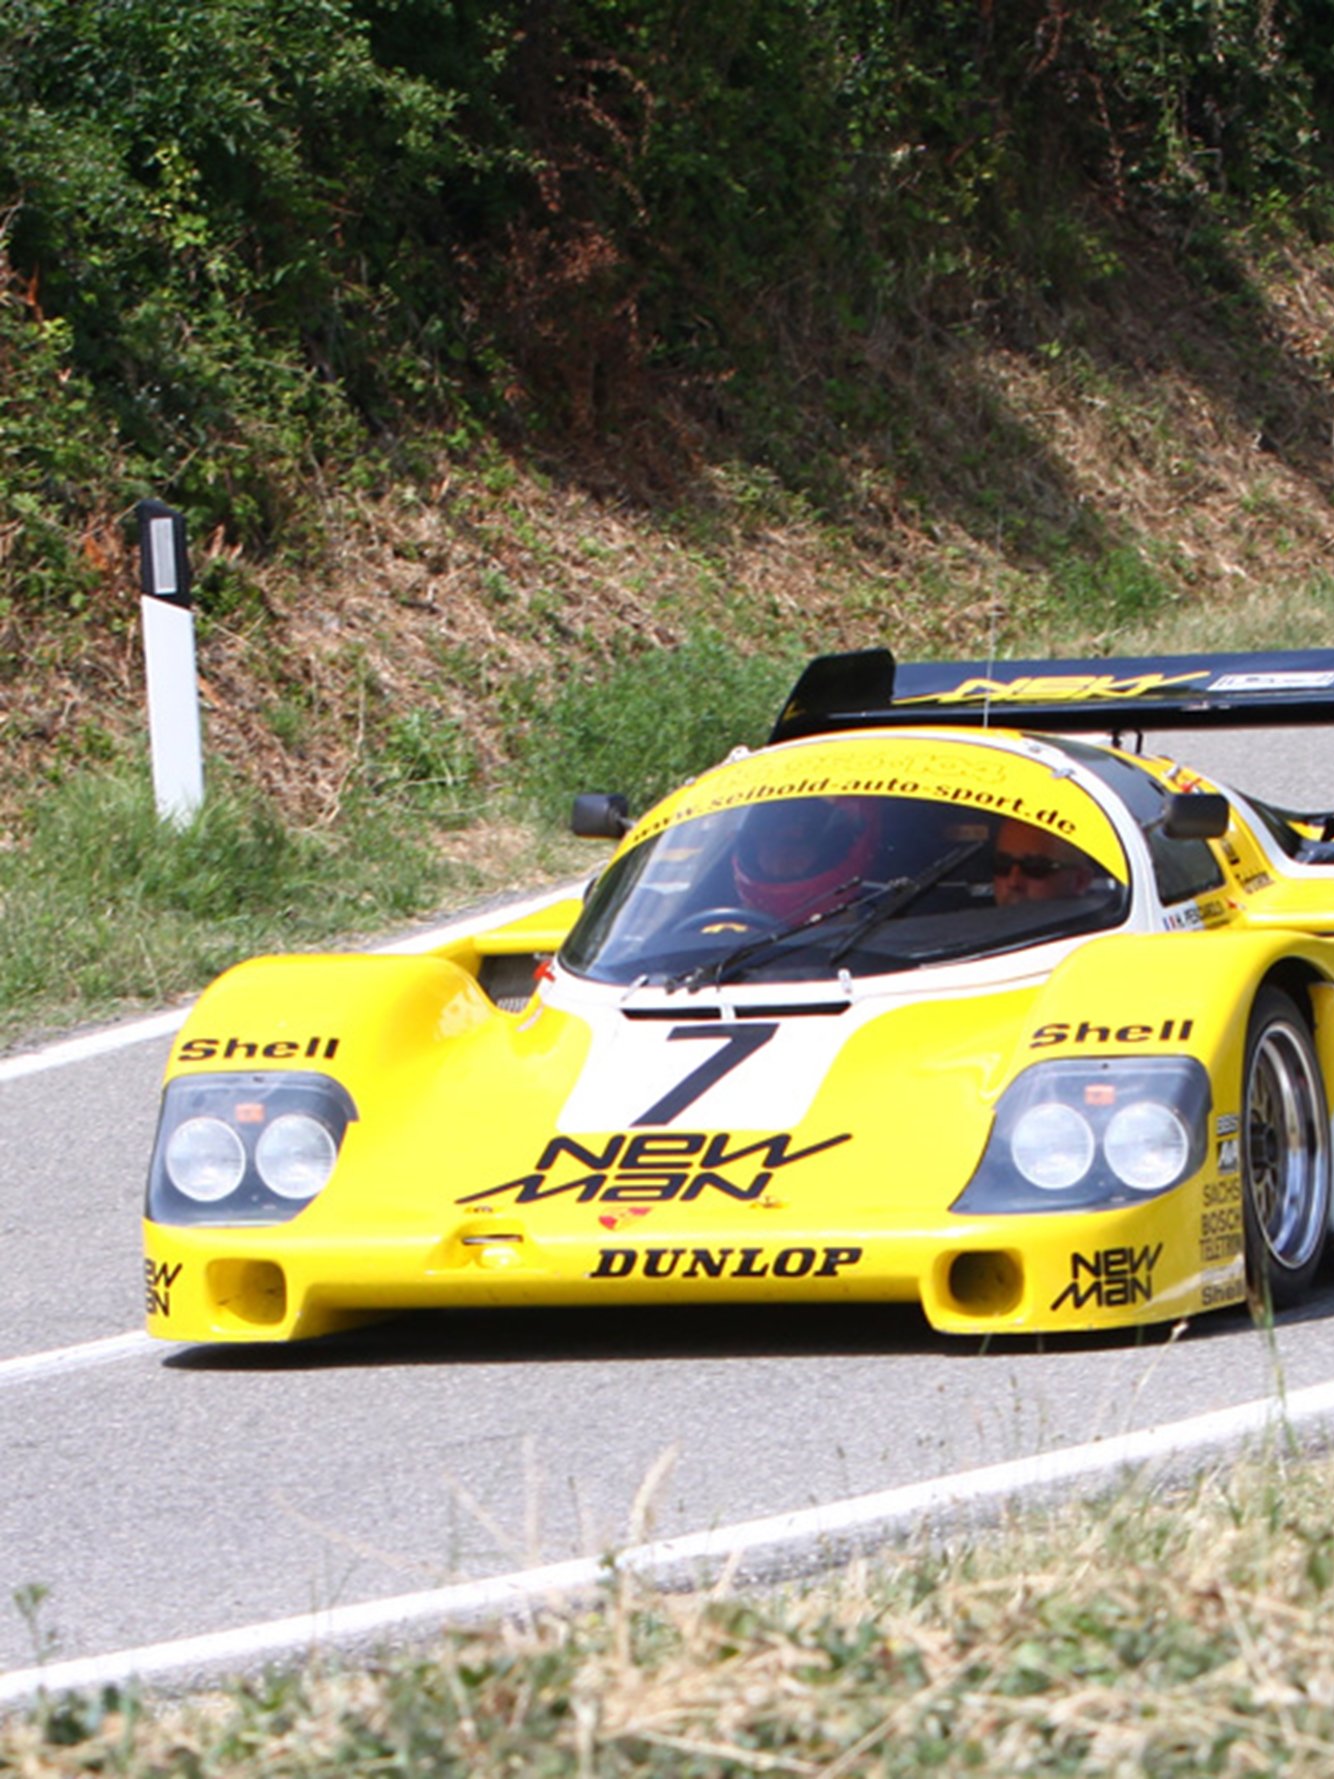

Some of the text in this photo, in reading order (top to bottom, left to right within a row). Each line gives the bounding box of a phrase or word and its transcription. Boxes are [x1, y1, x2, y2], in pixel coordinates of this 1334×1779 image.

[1030, 1020, 1194, 1049] Shell
[178, 1037, 339, 1062] Shell
[629, 1024, 781, 1127] 7
[588, 1247, 862, 1278] DUNLOP
[1202, 1278, 1246, 1307] Shell
